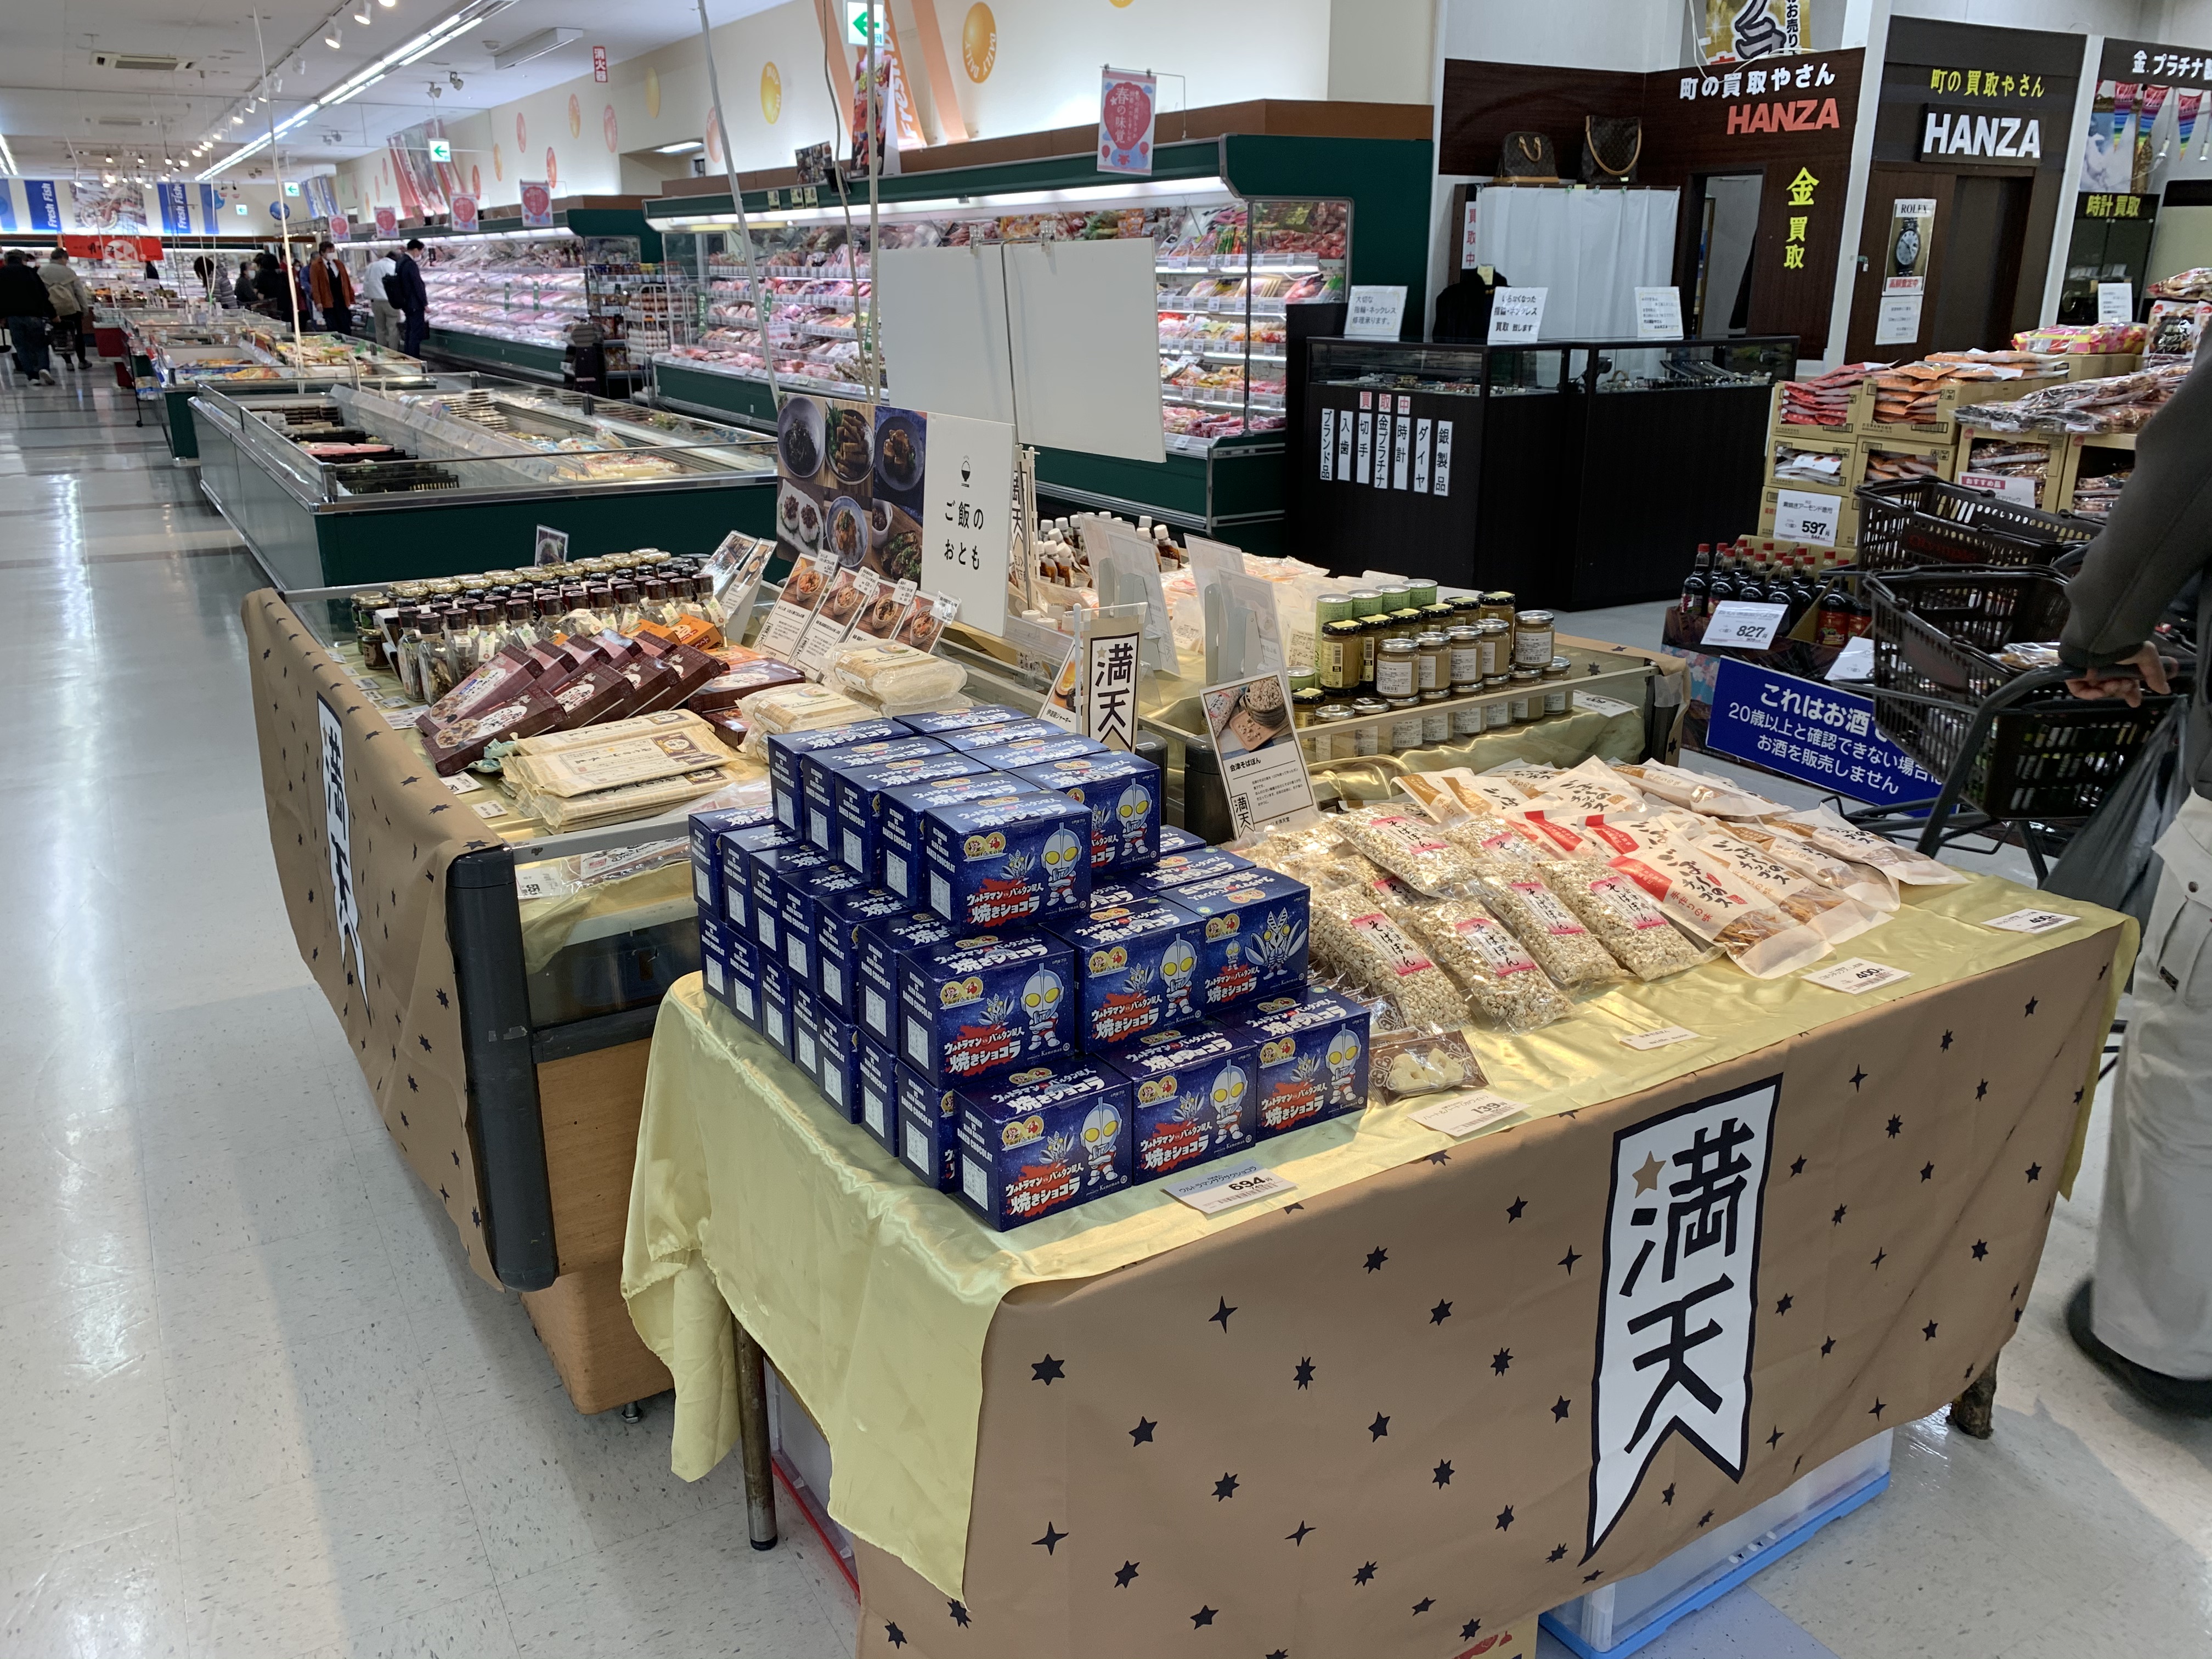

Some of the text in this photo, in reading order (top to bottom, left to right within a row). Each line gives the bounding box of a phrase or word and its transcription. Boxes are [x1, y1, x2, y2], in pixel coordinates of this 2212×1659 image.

[964, 41, 979, 79] DAILY
[983, 32, 996, 77] DAILY
[1679, 63, 1836, 100] 町の買取やさん
[1930, 69, 2045, 98] 町の買取やさん
[1111, 86, 1130, 144] 春の味覚
[1726, 98, 1840, 135] HANZA
[1922, 112, 2041, 159] HANZA
[1786, 167, 1819, 206] 金
[1320, 410, 1333, 479] ブランド品
[1339, 418, 1351, 455] 入歯
[1358, 420, 1369, 457] 切手
[1375, 415, 1390, 487] 金プラチナ
[1396, 424, 1408, 463] 時計
[1415, 426, 1429, 489] ダイヤ
[1435, 427, 1449, 492] 銀製品
[944, 501, 985, 531] ご飯の
[944, 542, 981, 571] おとも
[1095, 643, 1135, 736] 満天
[1757, 735, 1899, 795] お酒を販売しません
[1235, 797, 1251, 828] 満天
[936, 854, 956, 873] CHOCOLAT
[970, 895, 1040, 924] 焼きショコラ
[1670, 890, 1713, 923] 手作りの味
[1682, 878, 1733, 909] チップス
[1090, 913, 1181, 944] 焼きショコラ
[861, 961, 891, 991] BAKED CHOCOLAT
[948, 944, 1048, 975] 焼きショコラ
[915, 983, 919, 991] VS
[1206, 977, 1257, 1004] 焼きショコラ
[902, 990, 933, 1021] BAKED CHOCOLAT
[1261, 1005, 1347, 1037] 焼きショコラ
[1095, 1008, 1159, 1040] 焼きショコラ
[948, 1040, 1021, 1074] 焼きショコラ
[1041, 1047, 1062, 1057] Kameman
[1141, 1037, 1233, 1072] 焼きショコラ
[913, 1090, 918, 1099] VS
[1006, 1076, 1105, 1114] 焼きショコラ
[1264, 1095, 1324, 1127] 焼きショコラ
[901, 1096, 933, 1128] BAKED CHOCOLAT
[965, 1110, 983, 1129] ULTRAMAN
[971, 1122, 977, 1131] VS
[957, 1128, 993, 1163] BAKED CHOCOLAT
[1144, 1134, 1209, 1170] 焼きショコラ
[1009, 1176, 1081, 1216] 焼きショコラ
[1099, 1181, 1120, 1192] Kameman
[1618, 1117, 1756, 1454] 満天
